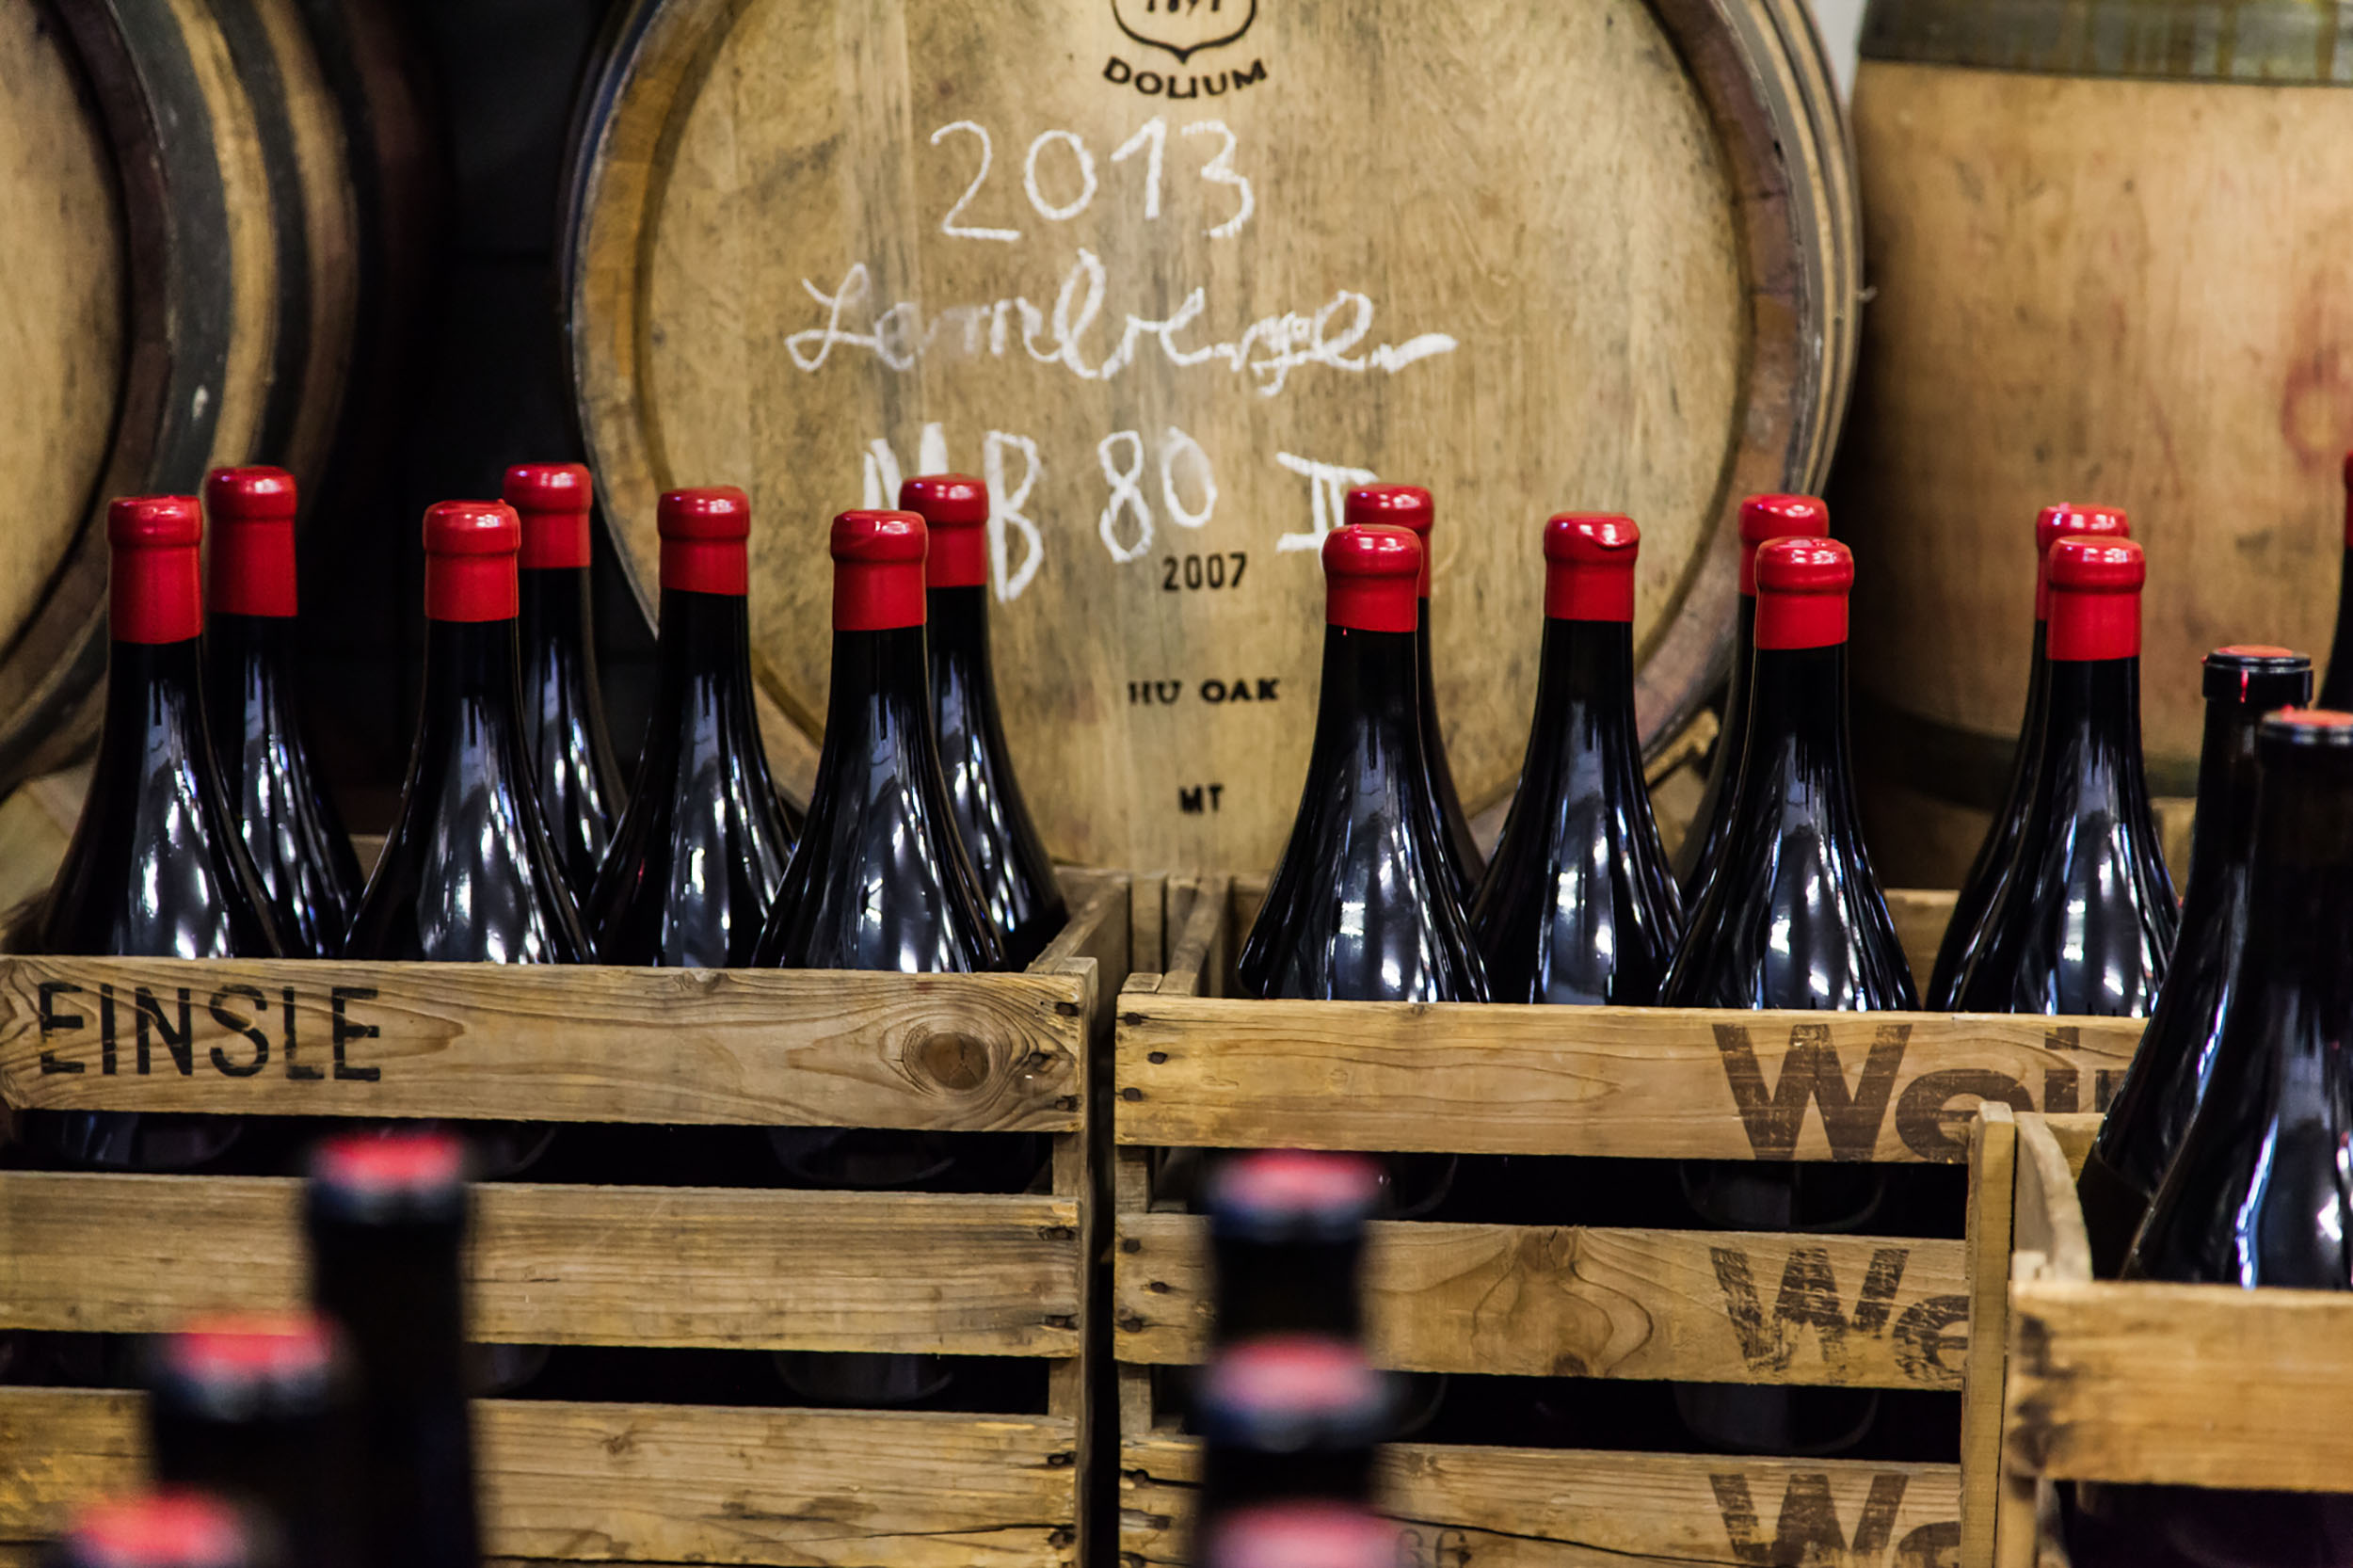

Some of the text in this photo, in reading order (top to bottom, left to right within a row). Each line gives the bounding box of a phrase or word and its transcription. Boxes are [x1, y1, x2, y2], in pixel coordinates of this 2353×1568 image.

[1103, 56, 1267, 99] DOLIUM
[931, 118, 1255, 240] 2013
[1097, 426, 1218, 563] 80
[1161, 552, 1247, 593] 2007
[1200, 678, 1281, 703] OAK
[1178, 783, 1225, 815] MT
[38, 982, 381, 1081] EINSLE
